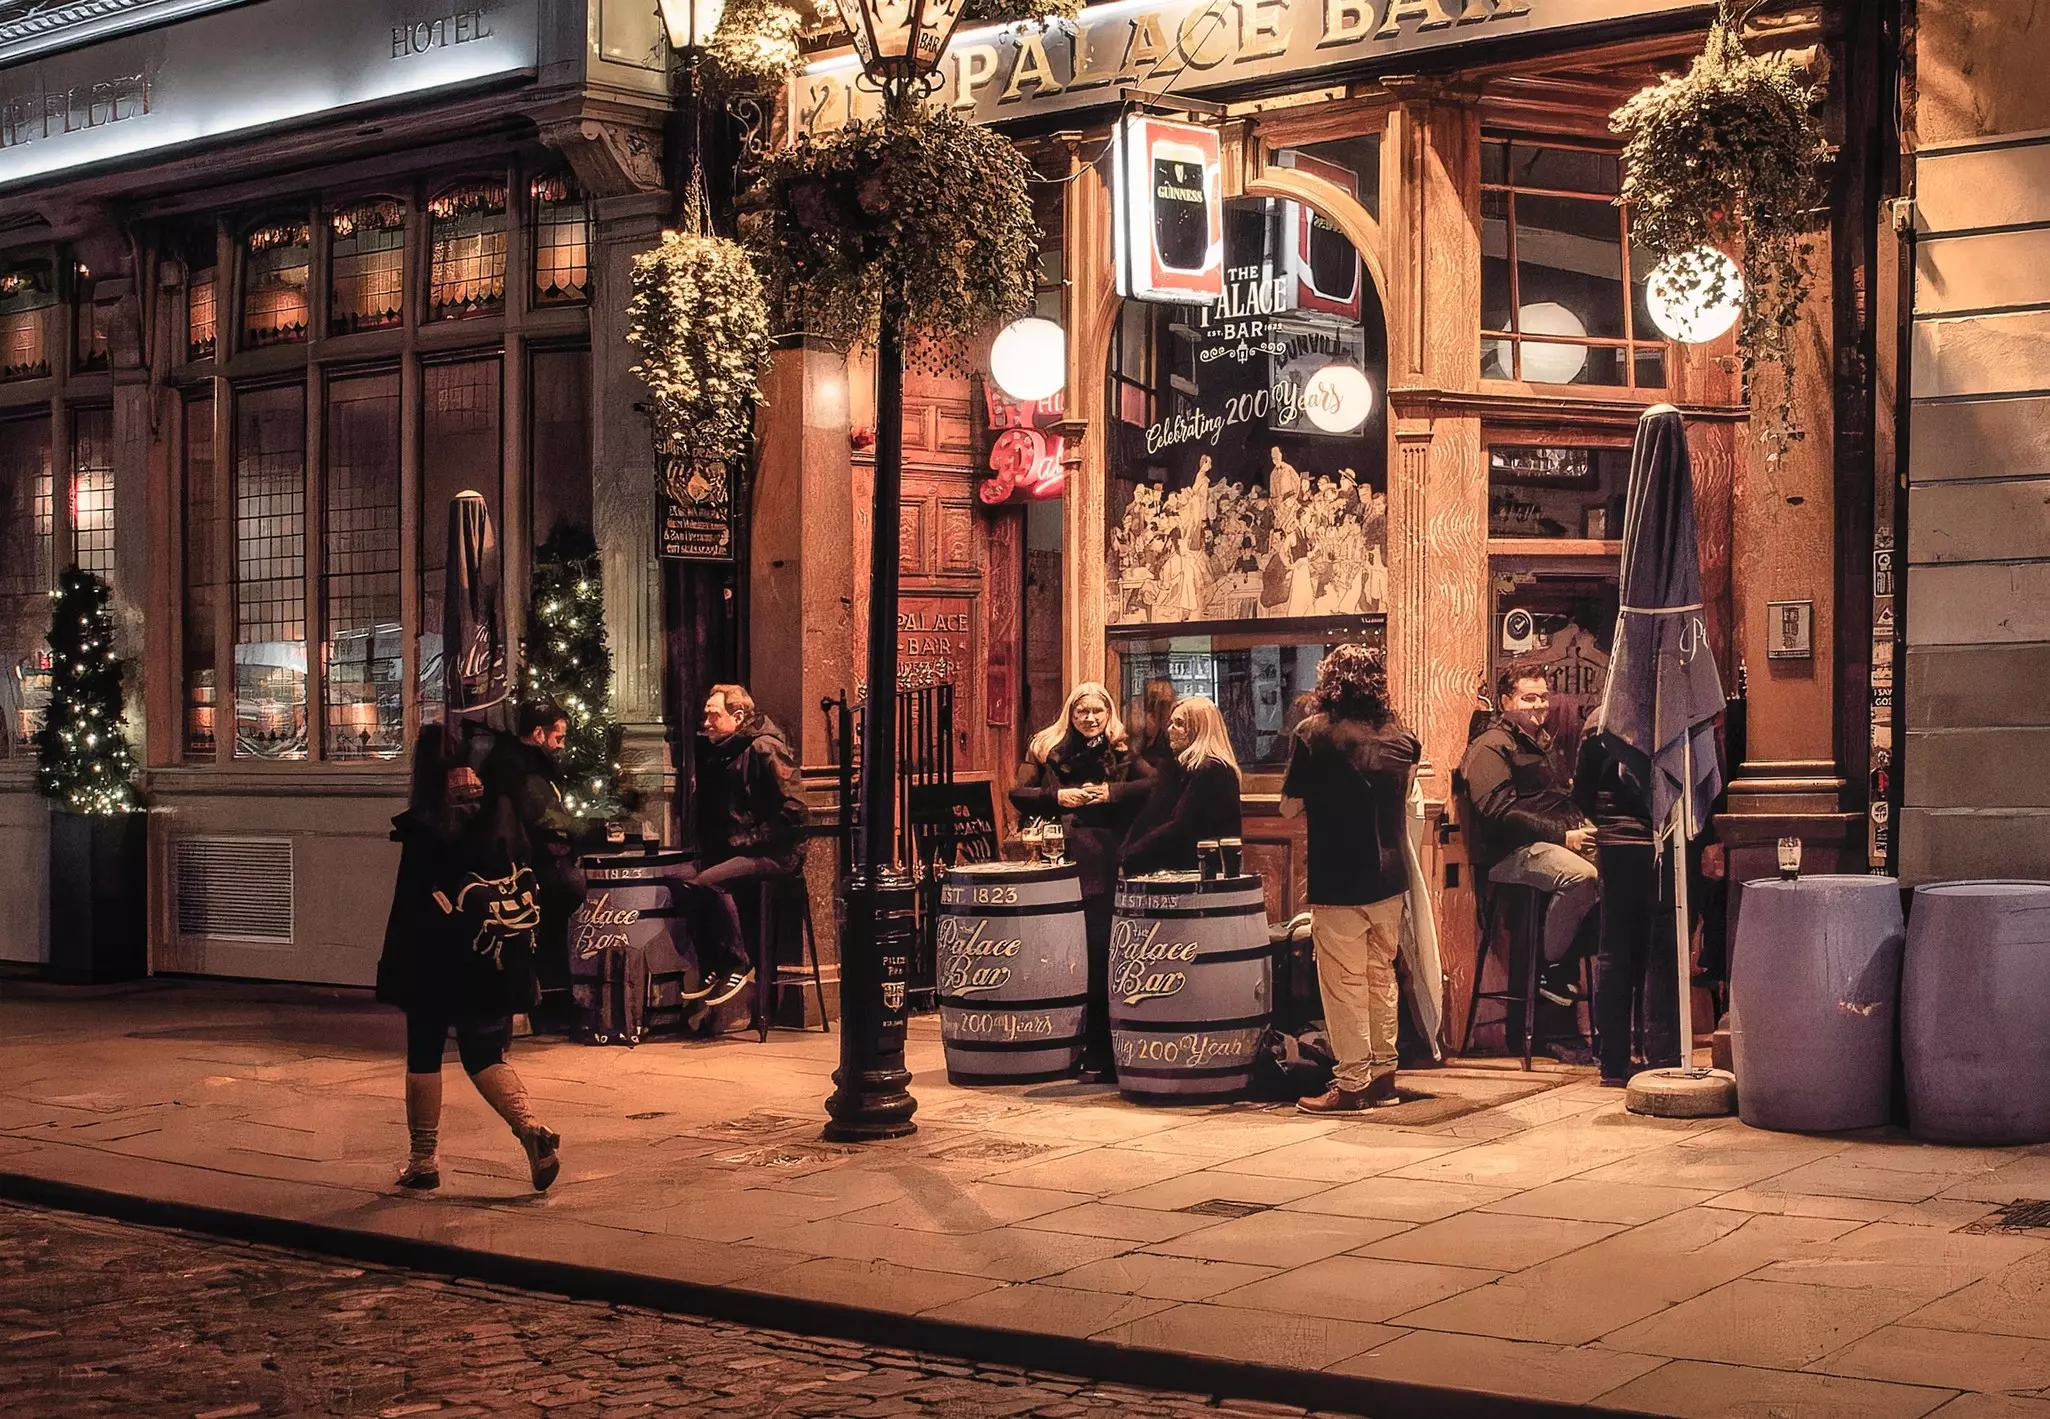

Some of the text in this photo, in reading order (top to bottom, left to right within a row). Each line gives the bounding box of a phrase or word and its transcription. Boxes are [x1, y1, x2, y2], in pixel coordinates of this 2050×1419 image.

[391, 9, 493, 60] HOTEL
[919, 32, 941, 53] BAR
[951, 0, 1294, 112] PALACE
[1157, 185, 1203, 203] GUINNESS
[1228, 266, 1258, 281] THE
[1224, 321, 1263, 340] BAR
[1146, 380, 1343, 455] Celebrating 200 Years
[908, 637, 952, 655] BAR
[577, 893, 640, 926] alace
[973, 887, 1018, 904] 1823
[1112, 920, 1198, 963] Palace
[942, 952, 1011, 997] Bar
[1112, 959, 1186, 1005] Bar
[1138, 1038, 1179, 1062] 200
